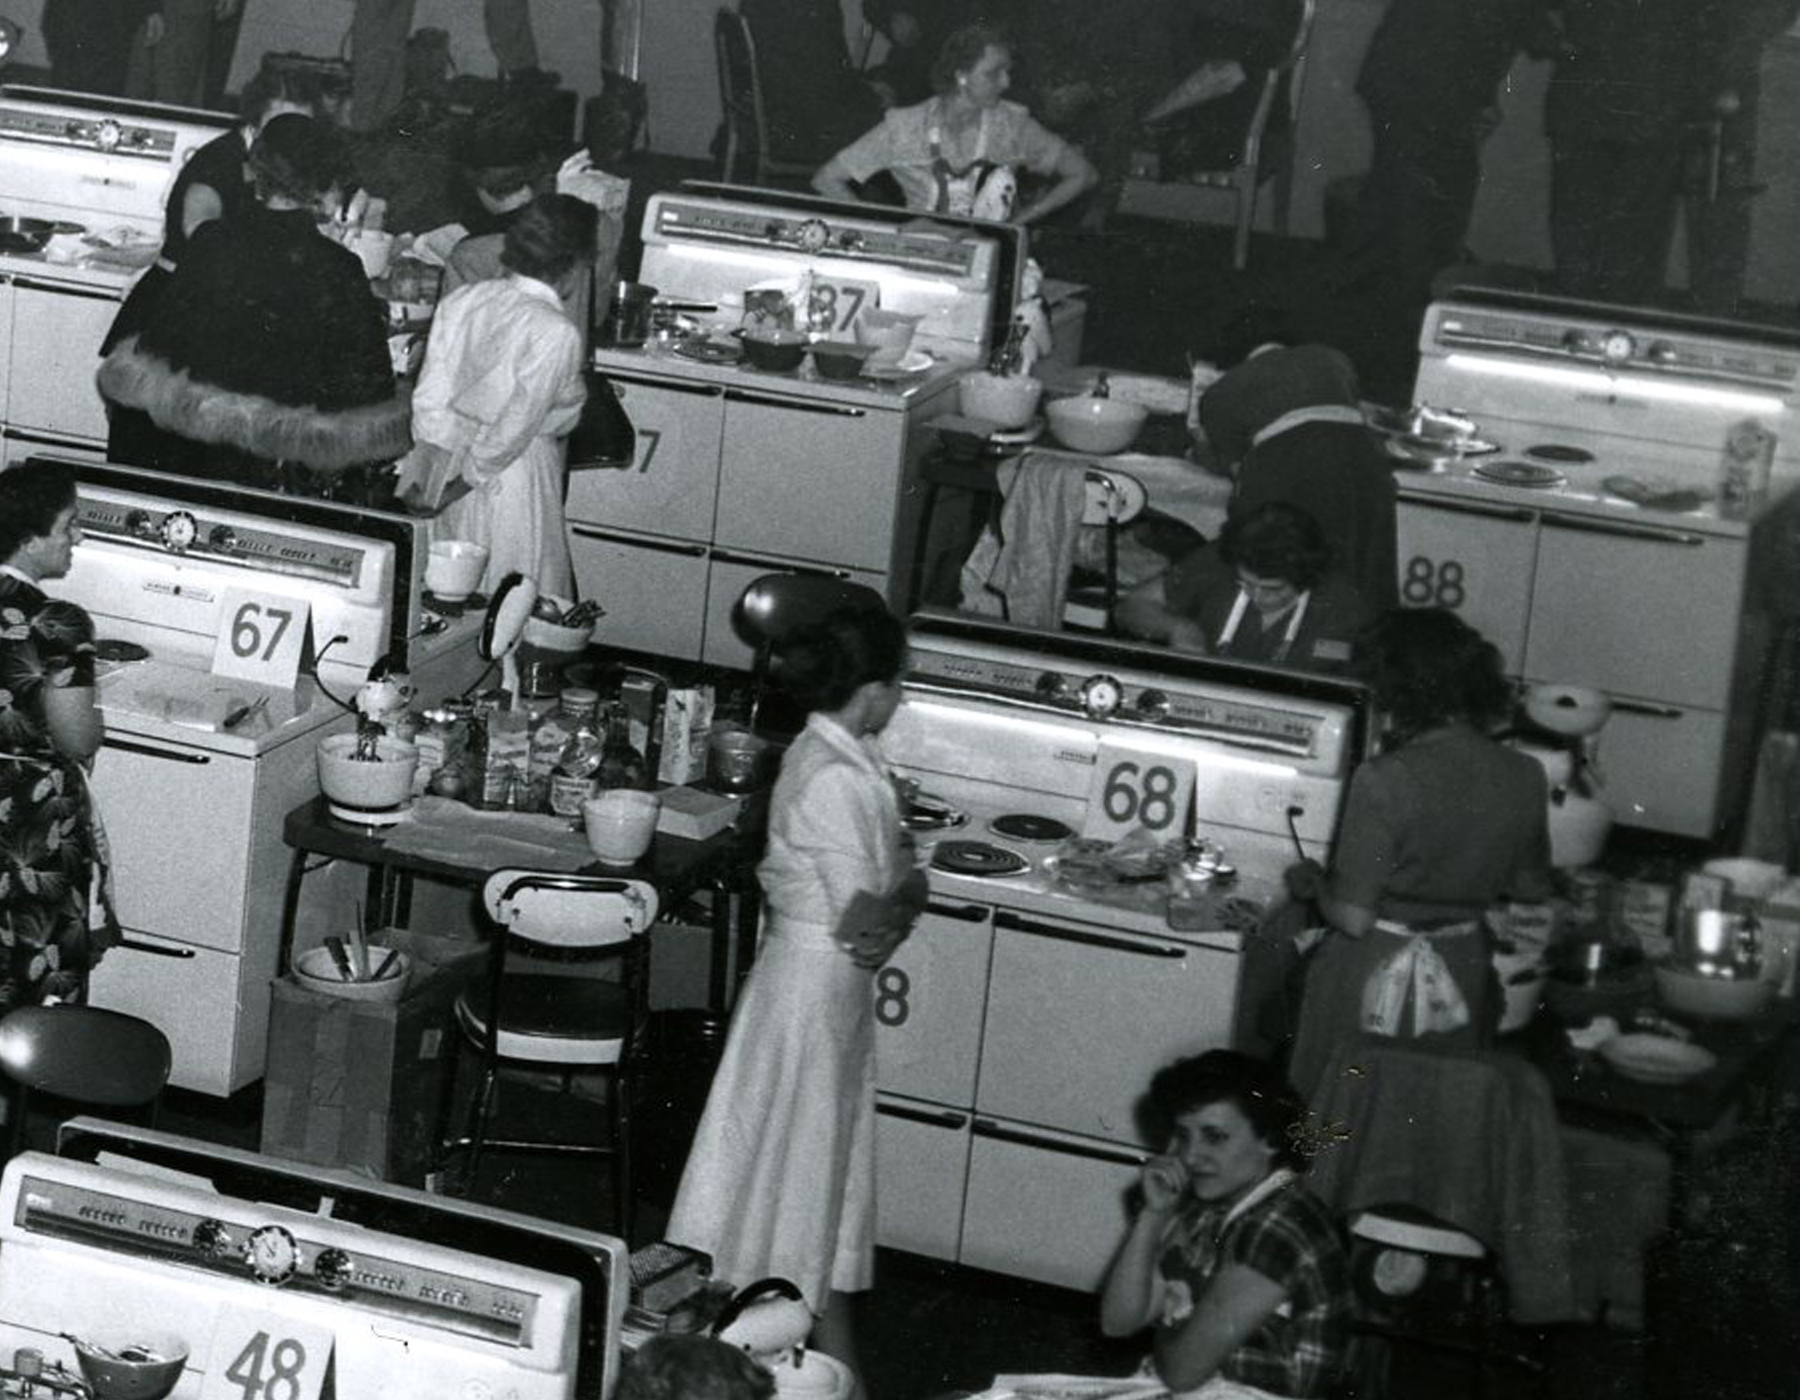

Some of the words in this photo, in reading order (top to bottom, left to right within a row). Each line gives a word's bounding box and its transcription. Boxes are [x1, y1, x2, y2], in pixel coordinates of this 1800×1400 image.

[1403, 555, 1466, 609] 88
[230, 602, 293, 662] 67
[1103, 761, 1178, 831] 68
